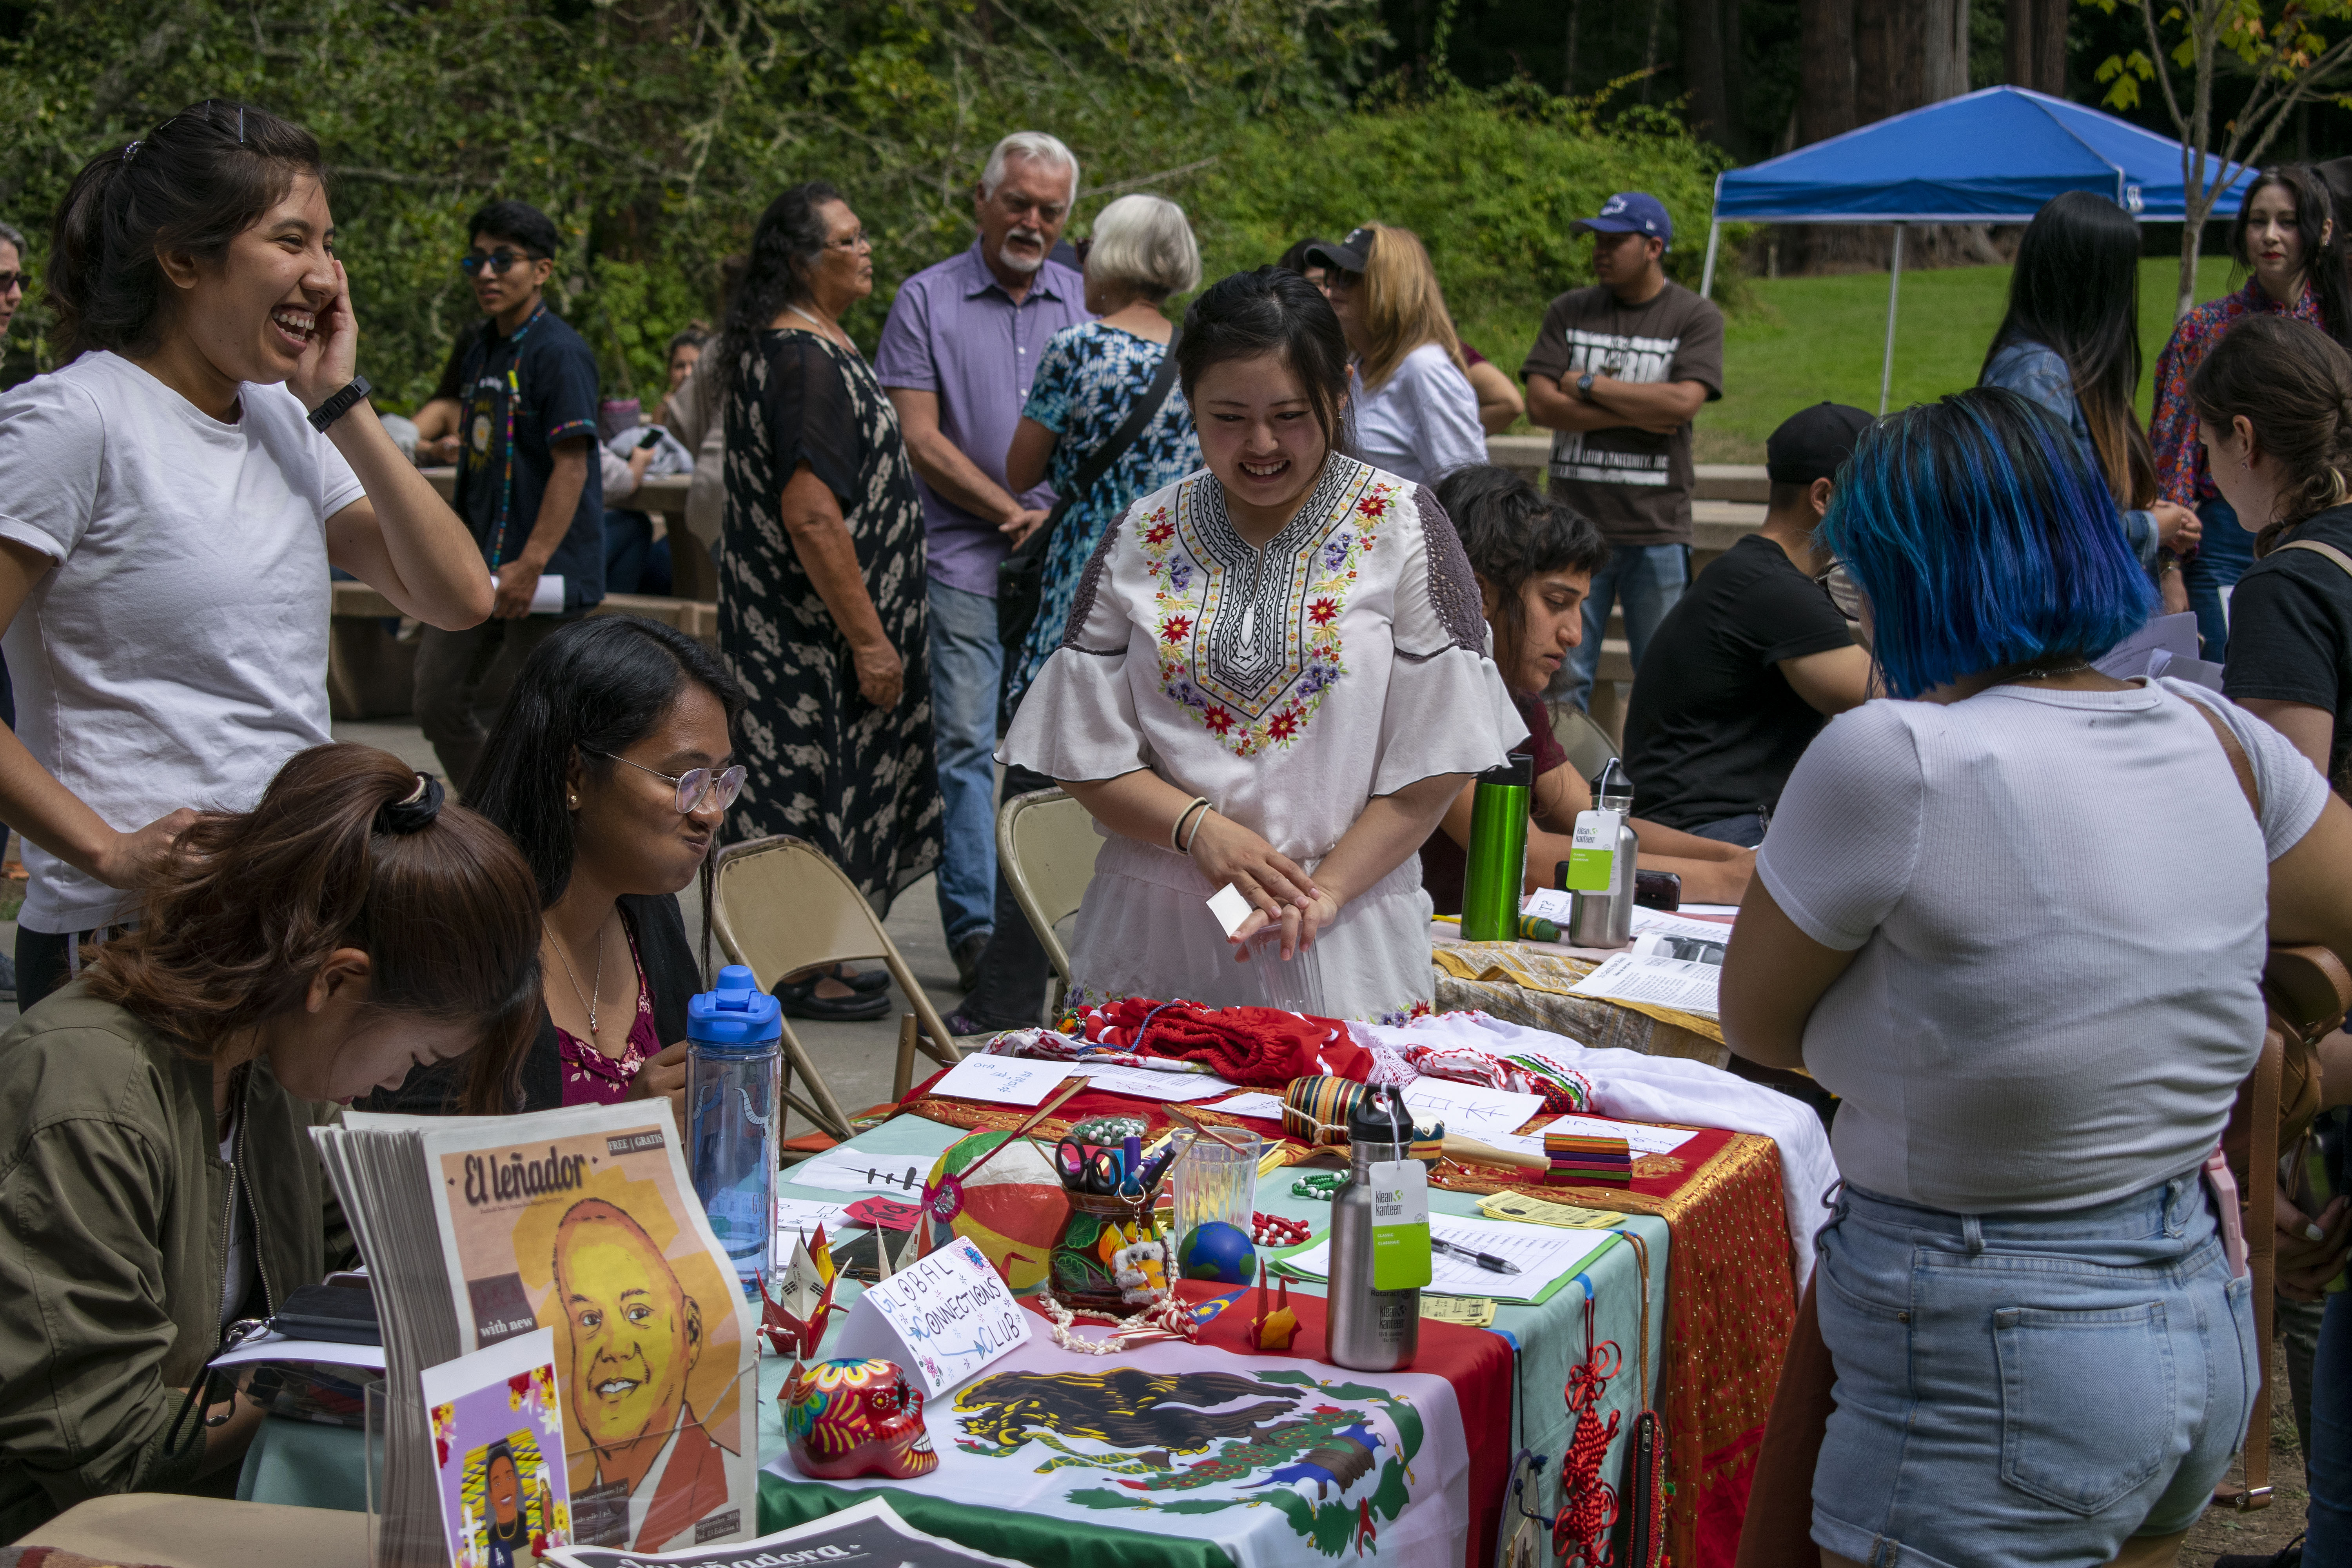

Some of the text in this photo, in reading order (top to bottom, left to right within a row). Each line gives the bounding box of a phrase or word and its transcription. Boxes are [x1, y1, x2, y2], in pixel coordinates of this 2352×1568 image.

[1575, 834, 1594, 843] kanteen
[1577, 826, 1590, 835] klean
[608, 1134, 663, 1152] FREE GRATIS
[465, 1145, 586, 1206] El leñador
[1375, 1190, 1392, 1203] klean
[1376, 1203, 1401, 1216] kanteen
[869, 1258, 954, 1314] GLOBAL
[912, 1277, 1001, 1339] CONNECTIONS
[1379, 1305, 1397, 1318] klean
[480, 1318, 533, 1337] with new
[1379, 1318, 1404, 1329] kanteen
[978, 1312, 1020, 1354] CLUB
[586, 1512, 598, 1521] asilo
[697, 1511, 739, 1530] septiembre 2019
[696, 1532, 706, 1540] Vol.
[714, 1524, 735, 1535] Edición
[495, 1547, 505, 1565] LA
